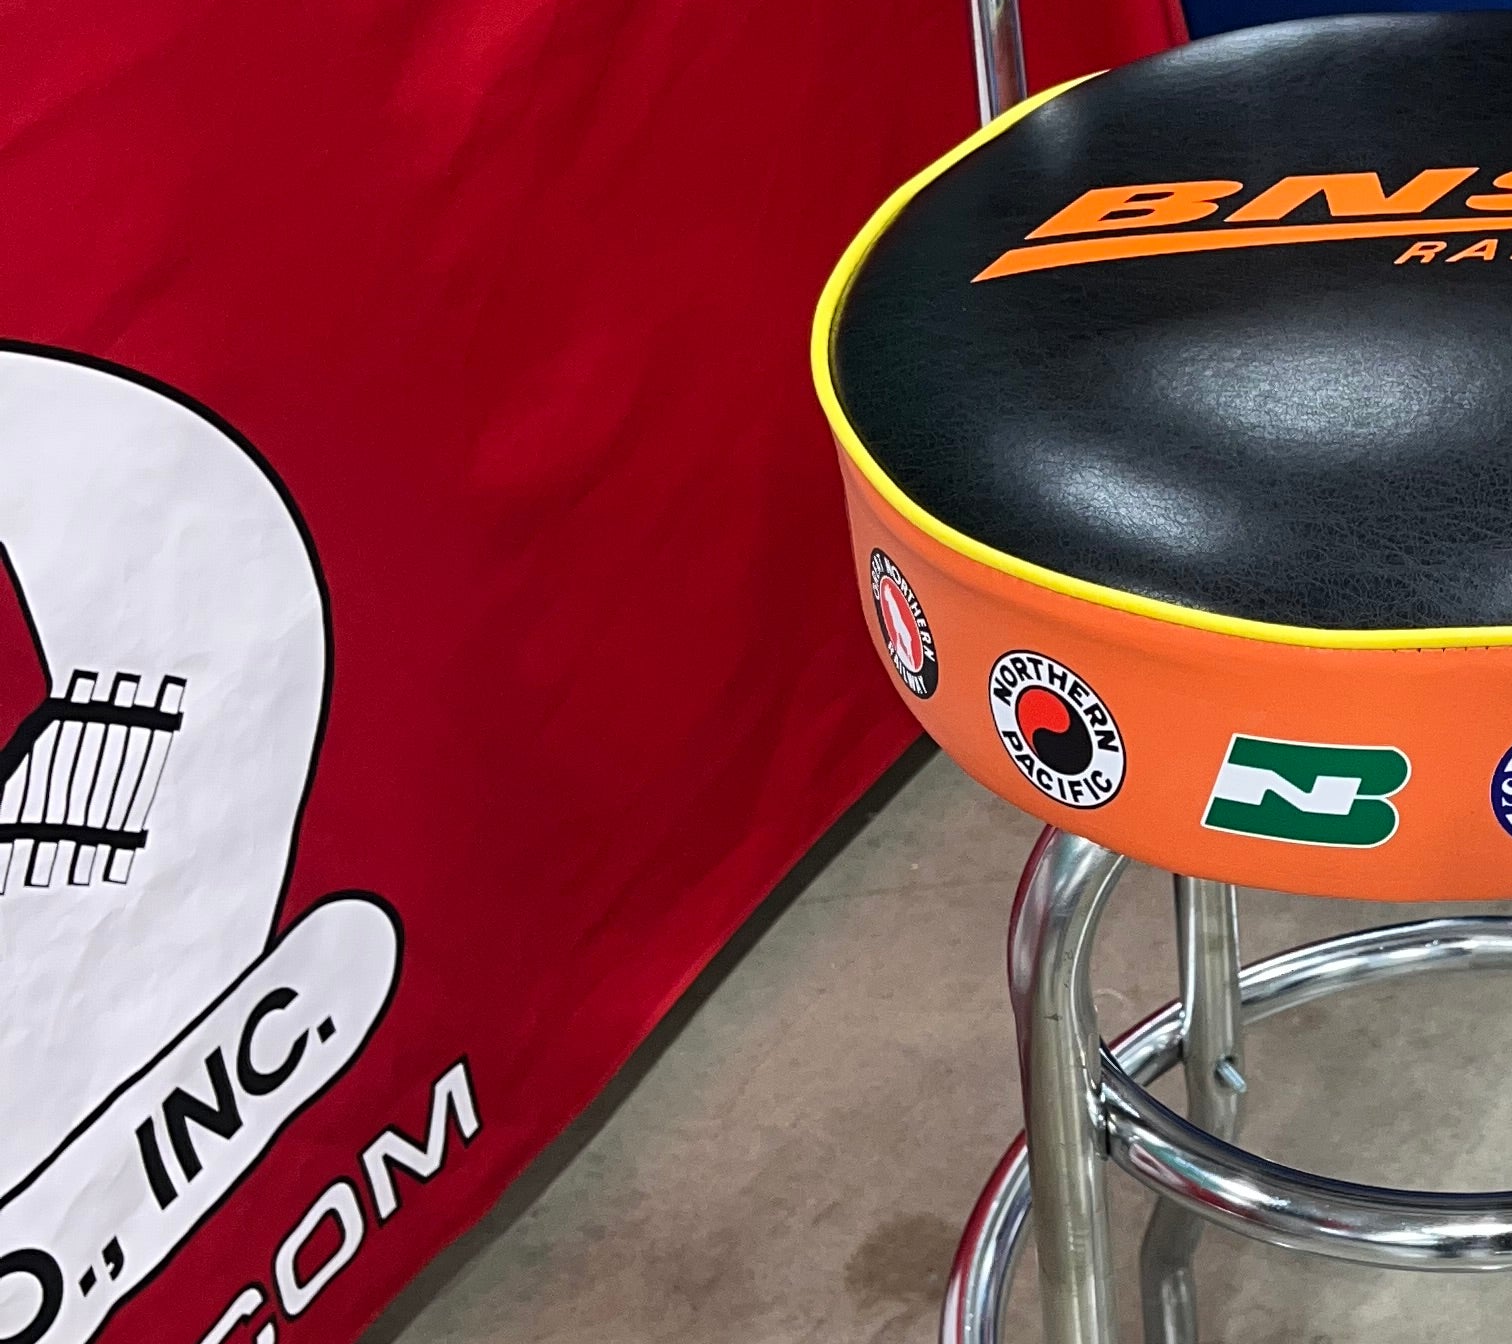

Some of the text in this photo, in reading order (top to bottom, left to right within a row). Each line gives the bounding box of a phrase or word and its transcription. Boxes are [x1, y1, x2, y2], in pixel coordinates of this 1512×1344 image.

[883, 556, 936, 662] NORTHERN
[888, 639, 928, 695] RAILWAY
[993, 656, 1119, 753] NORTHERN
[1002, 729, 1113, 804] PACIFIC
[135, 986, 337, 1211] INC.
